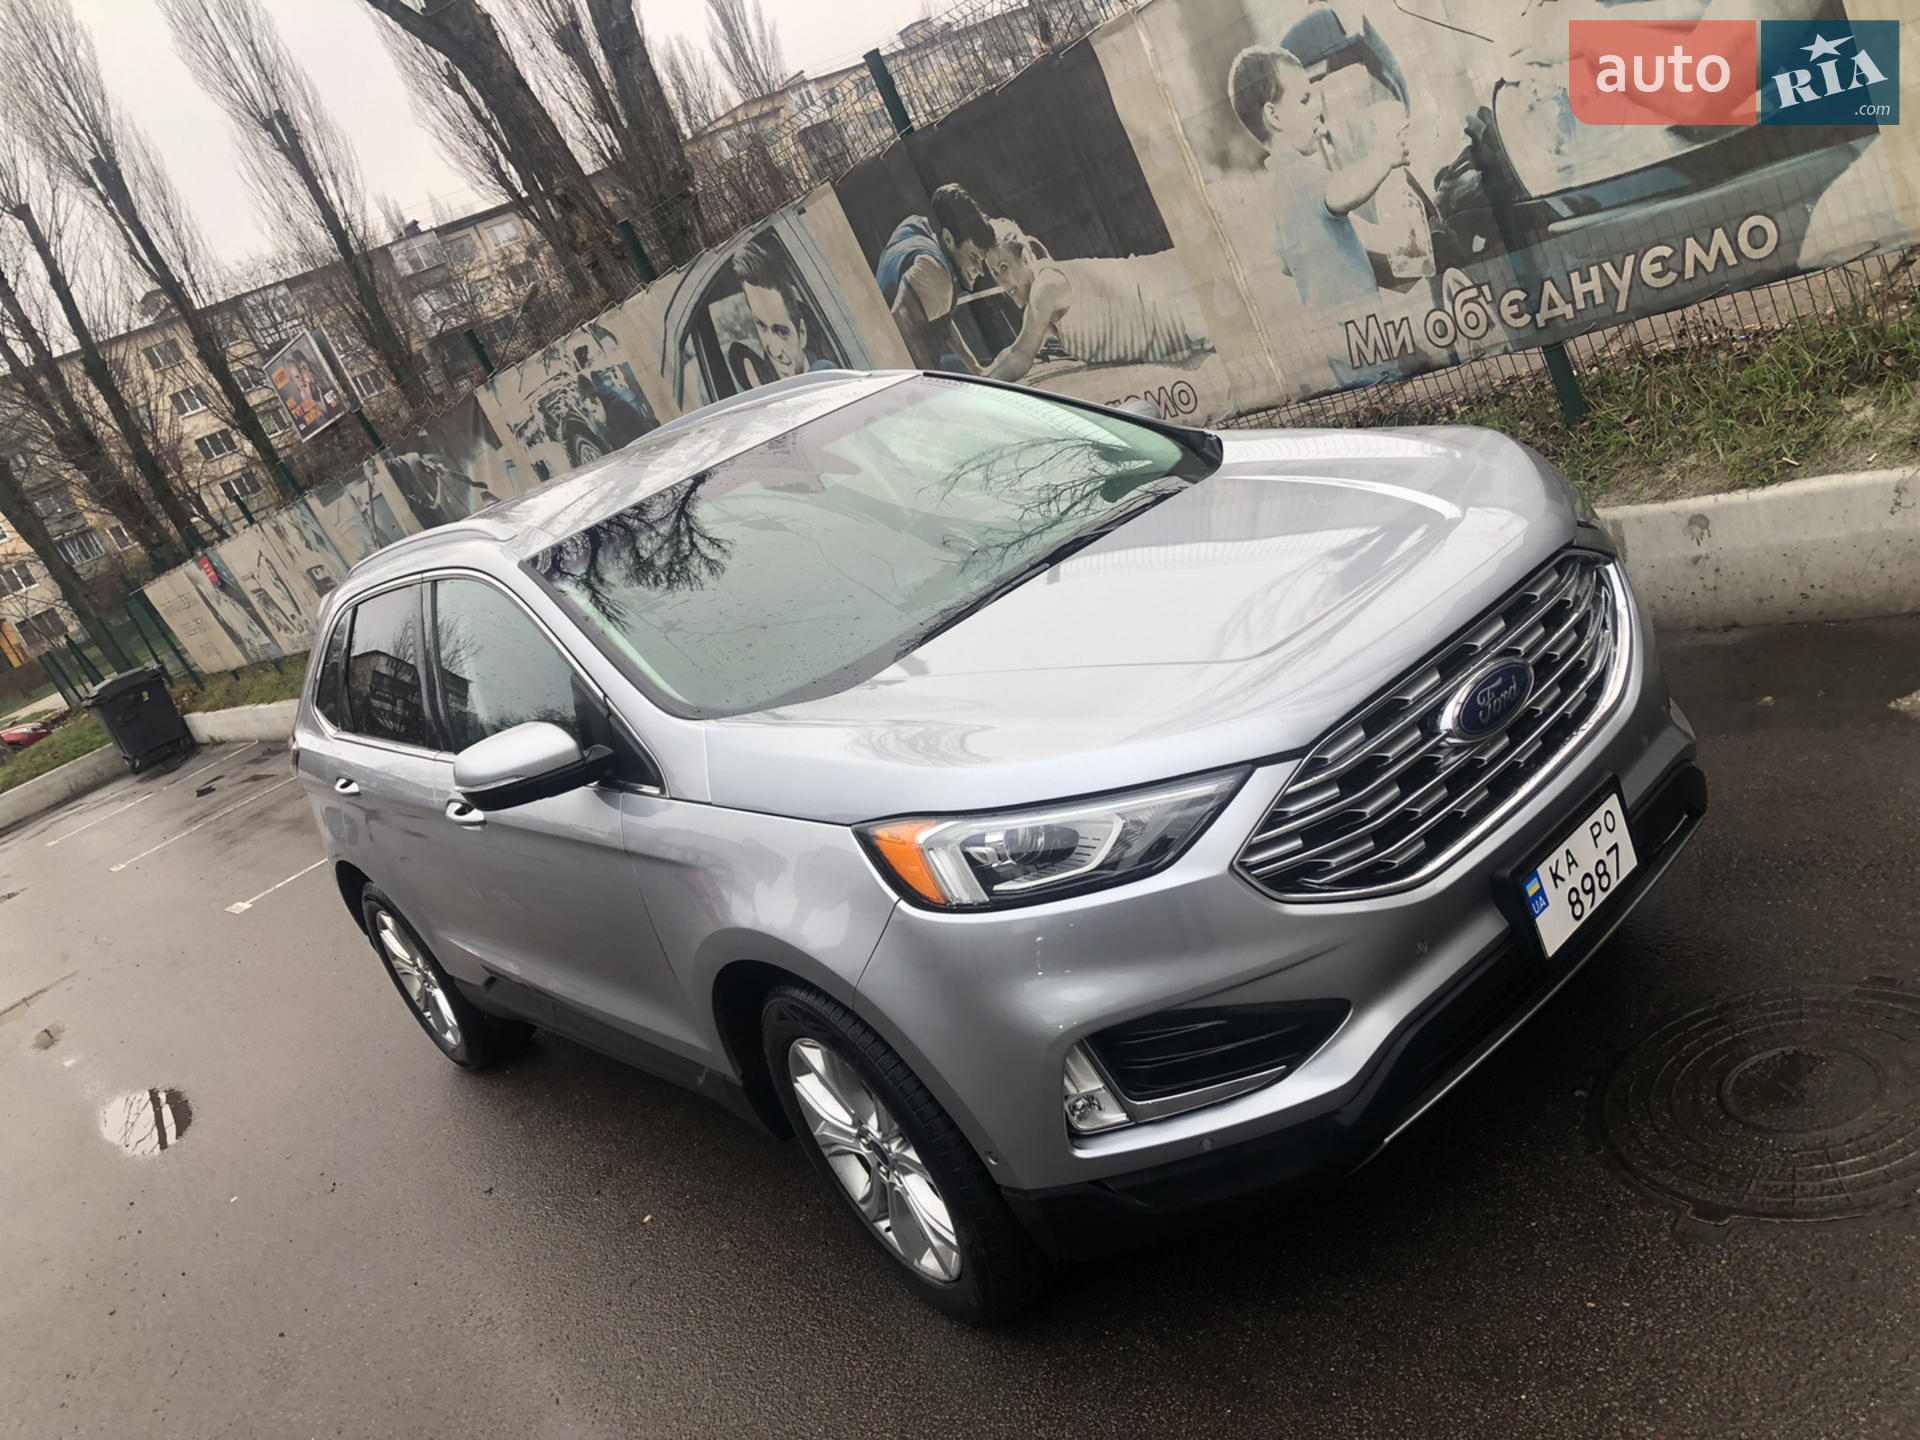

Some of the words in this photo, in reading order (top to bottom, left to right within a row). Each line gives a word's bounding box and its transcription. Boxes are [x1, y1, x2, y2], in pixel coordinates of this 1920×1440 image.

[1476, 674, 1518, 725] Ford
[1548, 848, 1579, 890] KA
[1567, 841, 1620, 921] 8987
[1531, 896, 1547, 914] UA
